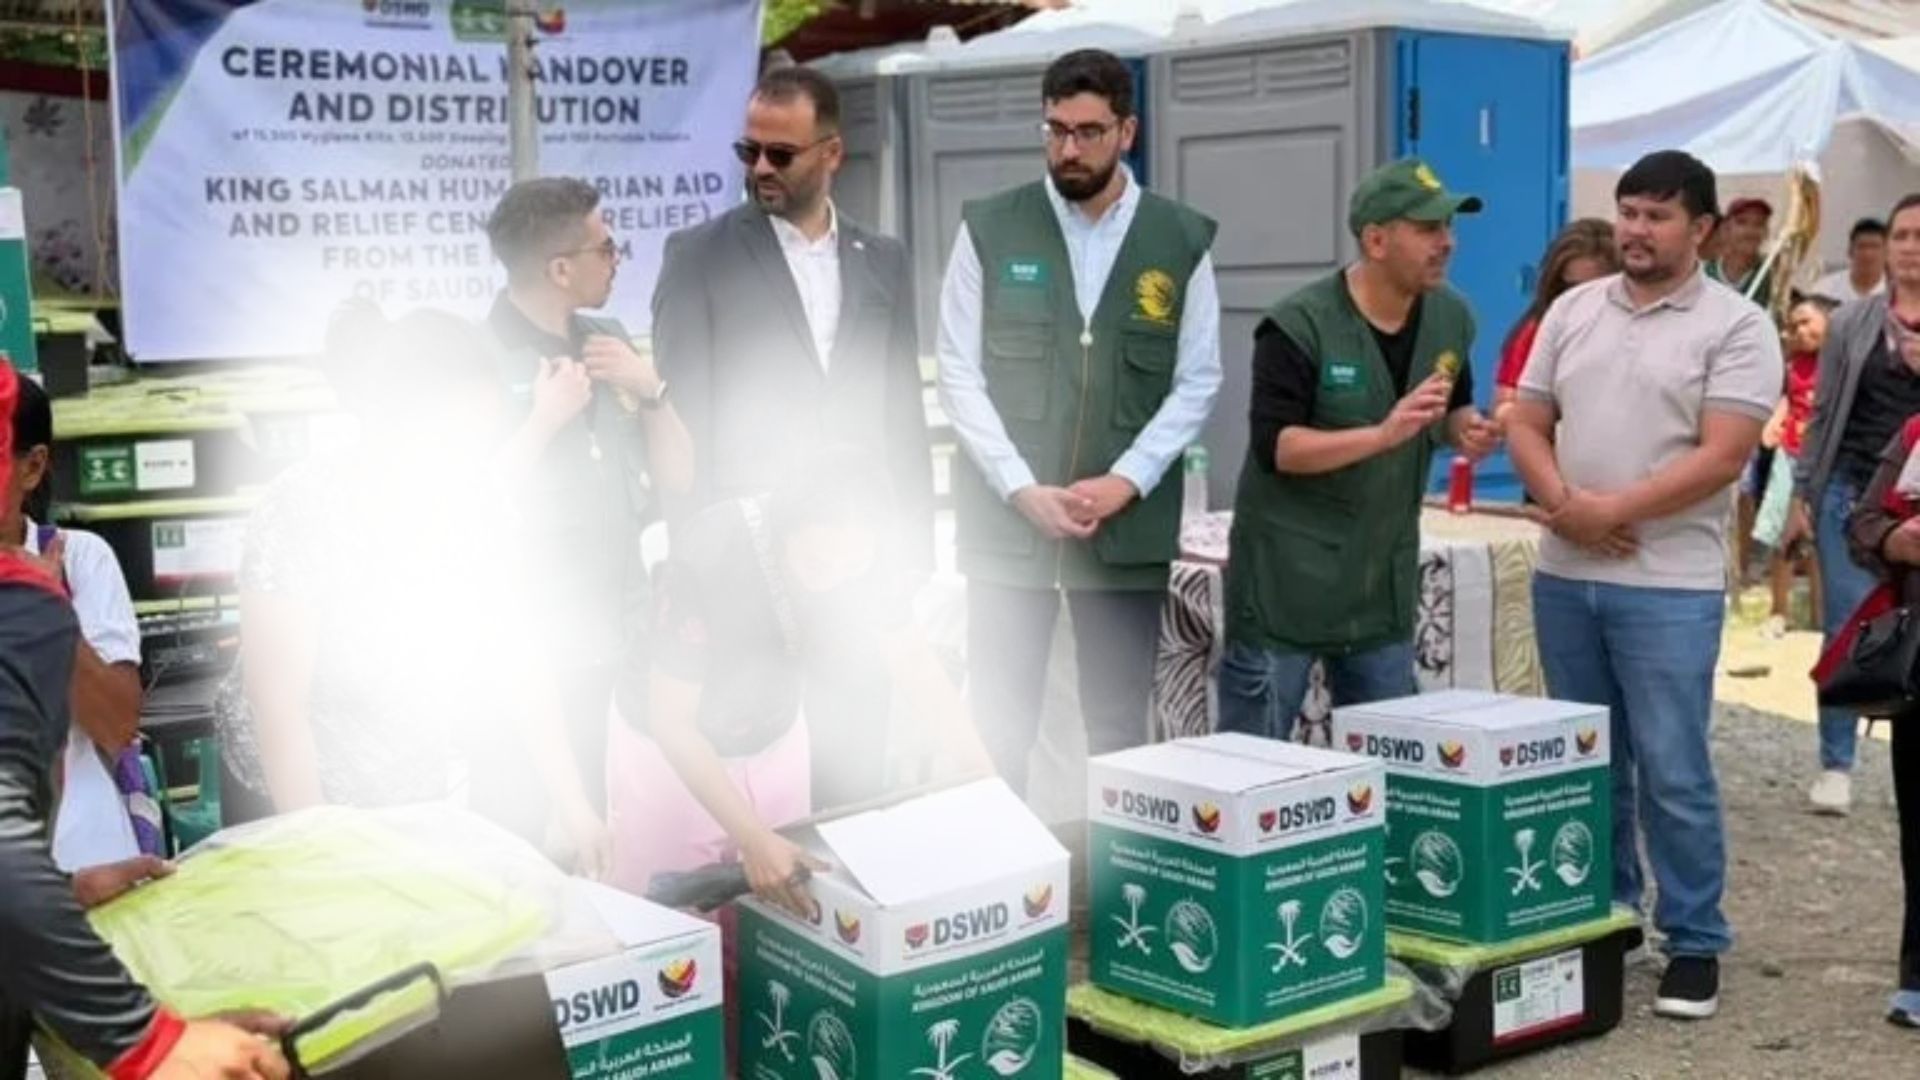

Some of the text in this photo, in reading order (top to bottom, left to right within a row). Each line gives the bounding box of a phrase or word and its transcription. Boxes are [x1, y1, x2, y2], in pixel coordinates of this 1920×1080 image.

[222, 46, 489, 82] CEREMONIAL
[288, 91, 640, 125] AND DISTRIUTION
[205, 177, 291, 202] KING
[301, 178, 428, 203] SALMAN
[674, 171, 723, 196] AID
[228, 211, 301, 238] AND
[312, 211, 418, 236] RELIEF
[322, 245, 414, 270] FROM
[423, 243, 481, 267] THE
[352, 276, 493, 302] OF SAUDI
[1366, 734, 1424, 763] DSWD
[1516, 737, 1567, 766] DSWD
[1121, 790, 1181, 825] DSWD
[1278, 796, 1337, 832] DSWD
[934, 902, 1009, 946] DSWD
[552, 979, 641, 1028] DSWD
